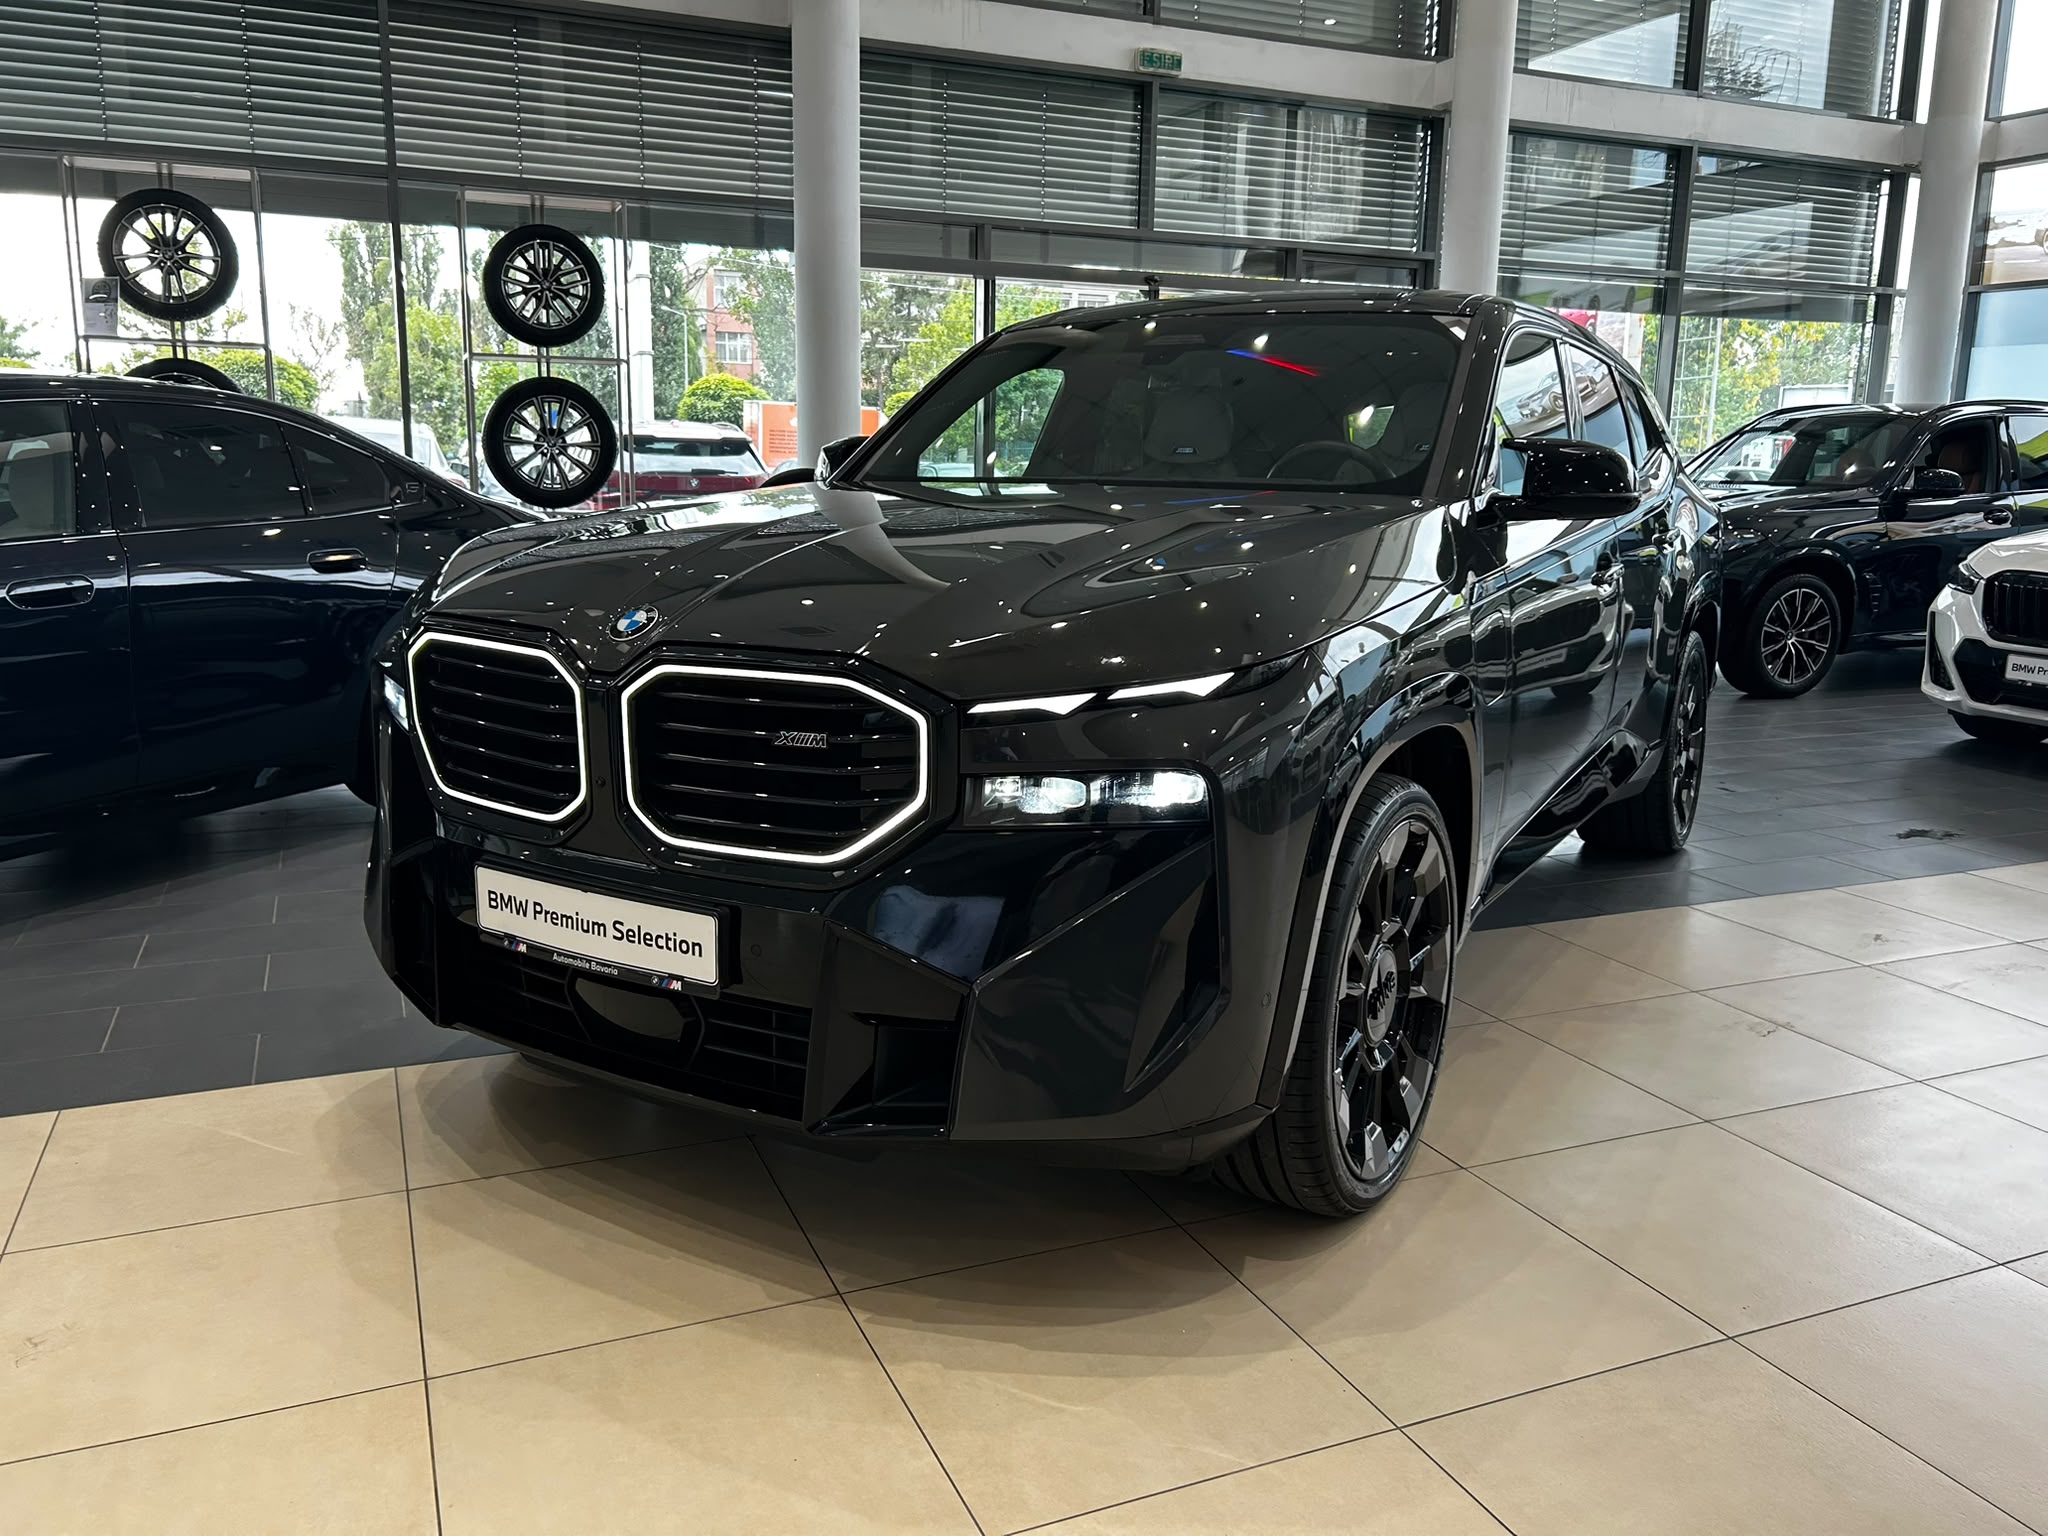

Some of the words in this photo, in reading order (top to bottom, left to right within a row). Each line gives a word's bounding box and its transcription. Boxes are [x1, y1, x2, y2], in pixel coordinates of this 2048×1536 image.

[2011, 663, 2036, 674] BMW
[488, 889, 528, 917] BMW
[533, 901, 607, 938] Premium
[612, 919, 703, 958] Selection
[552, 952, 590, 969] Automobile
[591, 961, 618, 975] Bavaria
